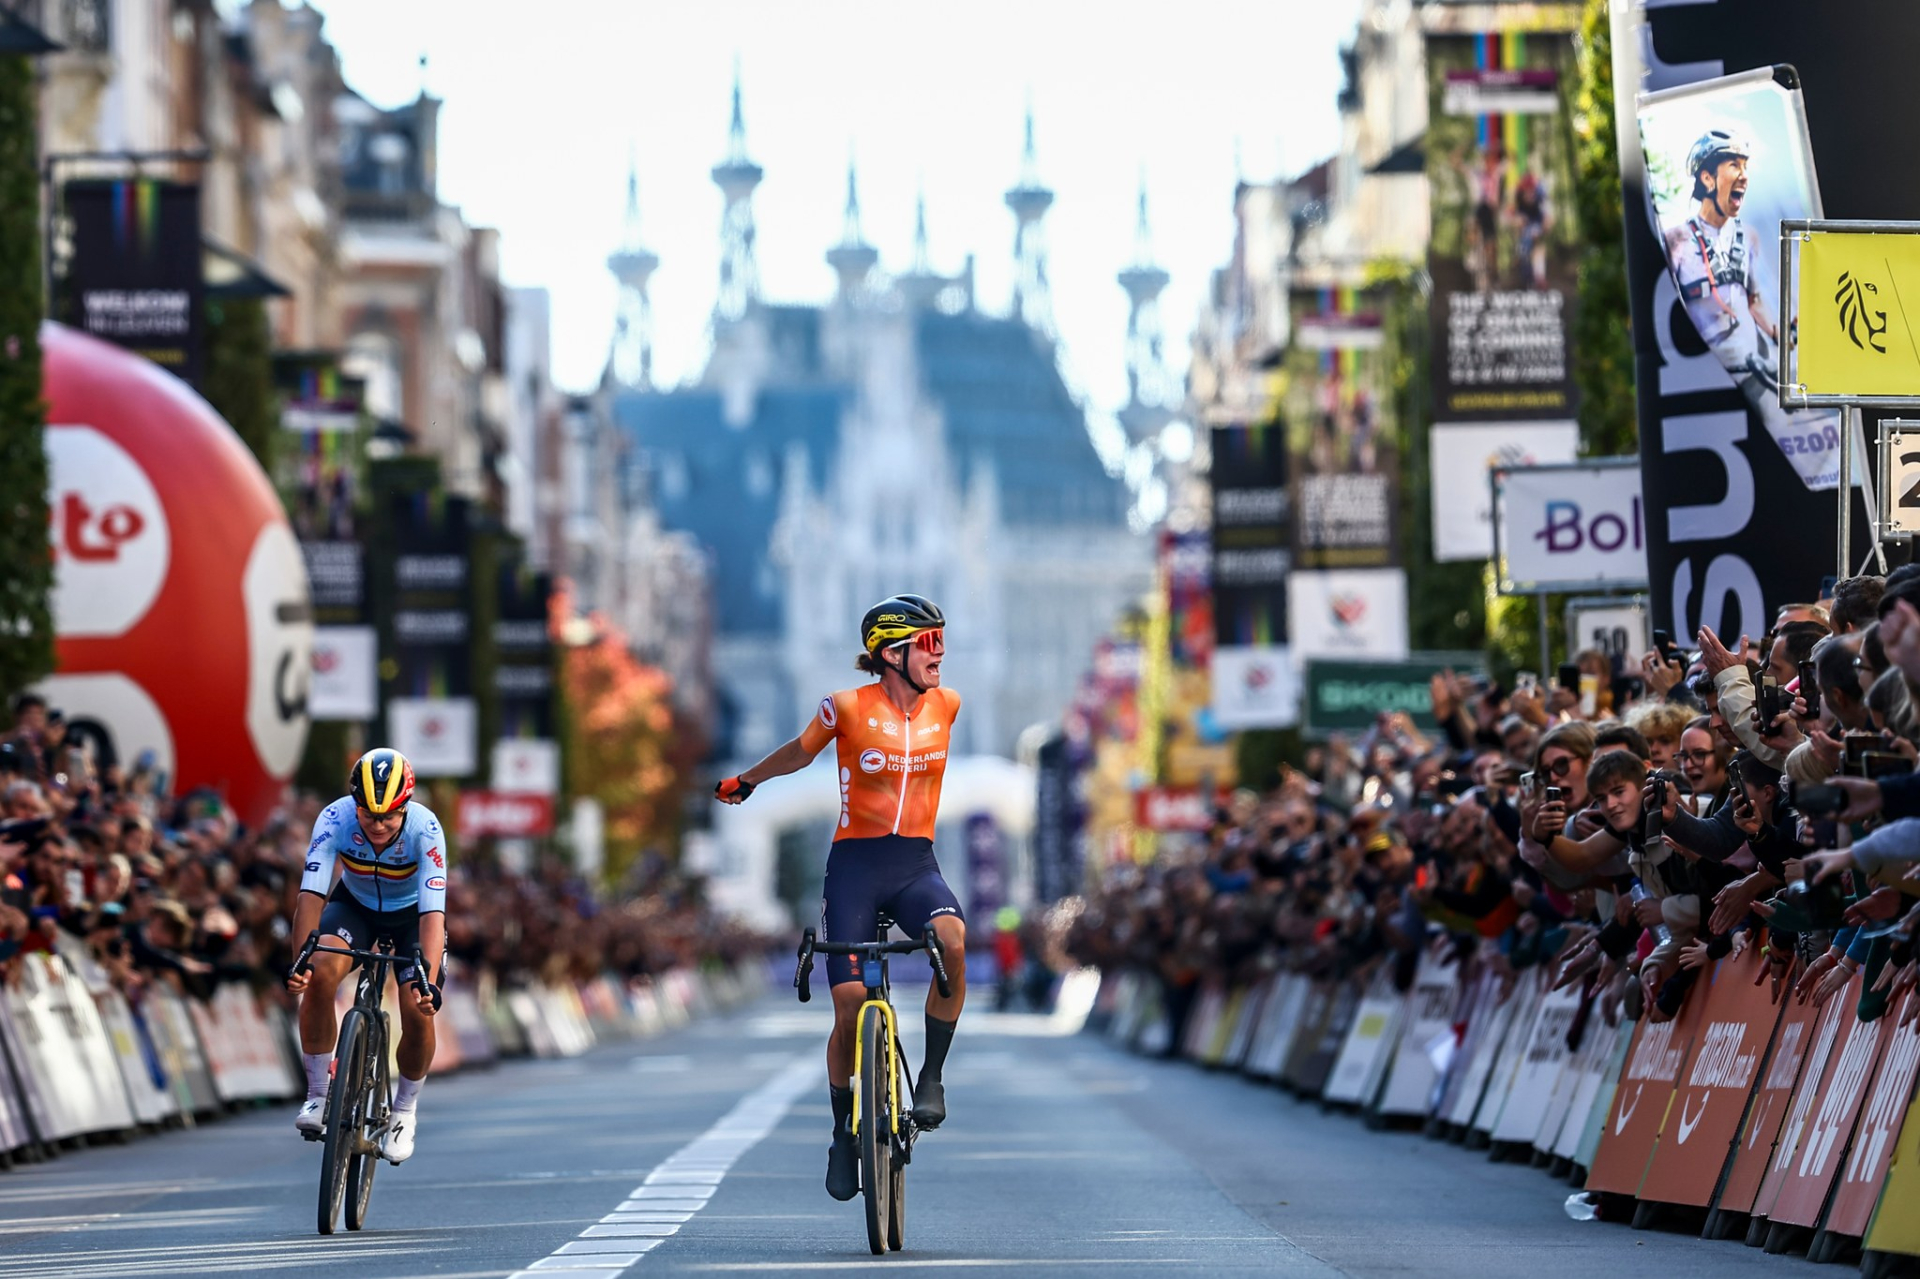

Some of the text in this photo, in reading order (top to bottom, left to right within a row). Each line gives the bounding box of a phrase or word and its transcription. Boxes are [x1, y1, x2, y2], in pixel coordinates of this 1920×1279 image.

[877, 613, 907, 623] GIRO
[888, 750, 946, 765] NEDERLANDSE
[1689, 1021, 1756, 1089] amazon.com.be
